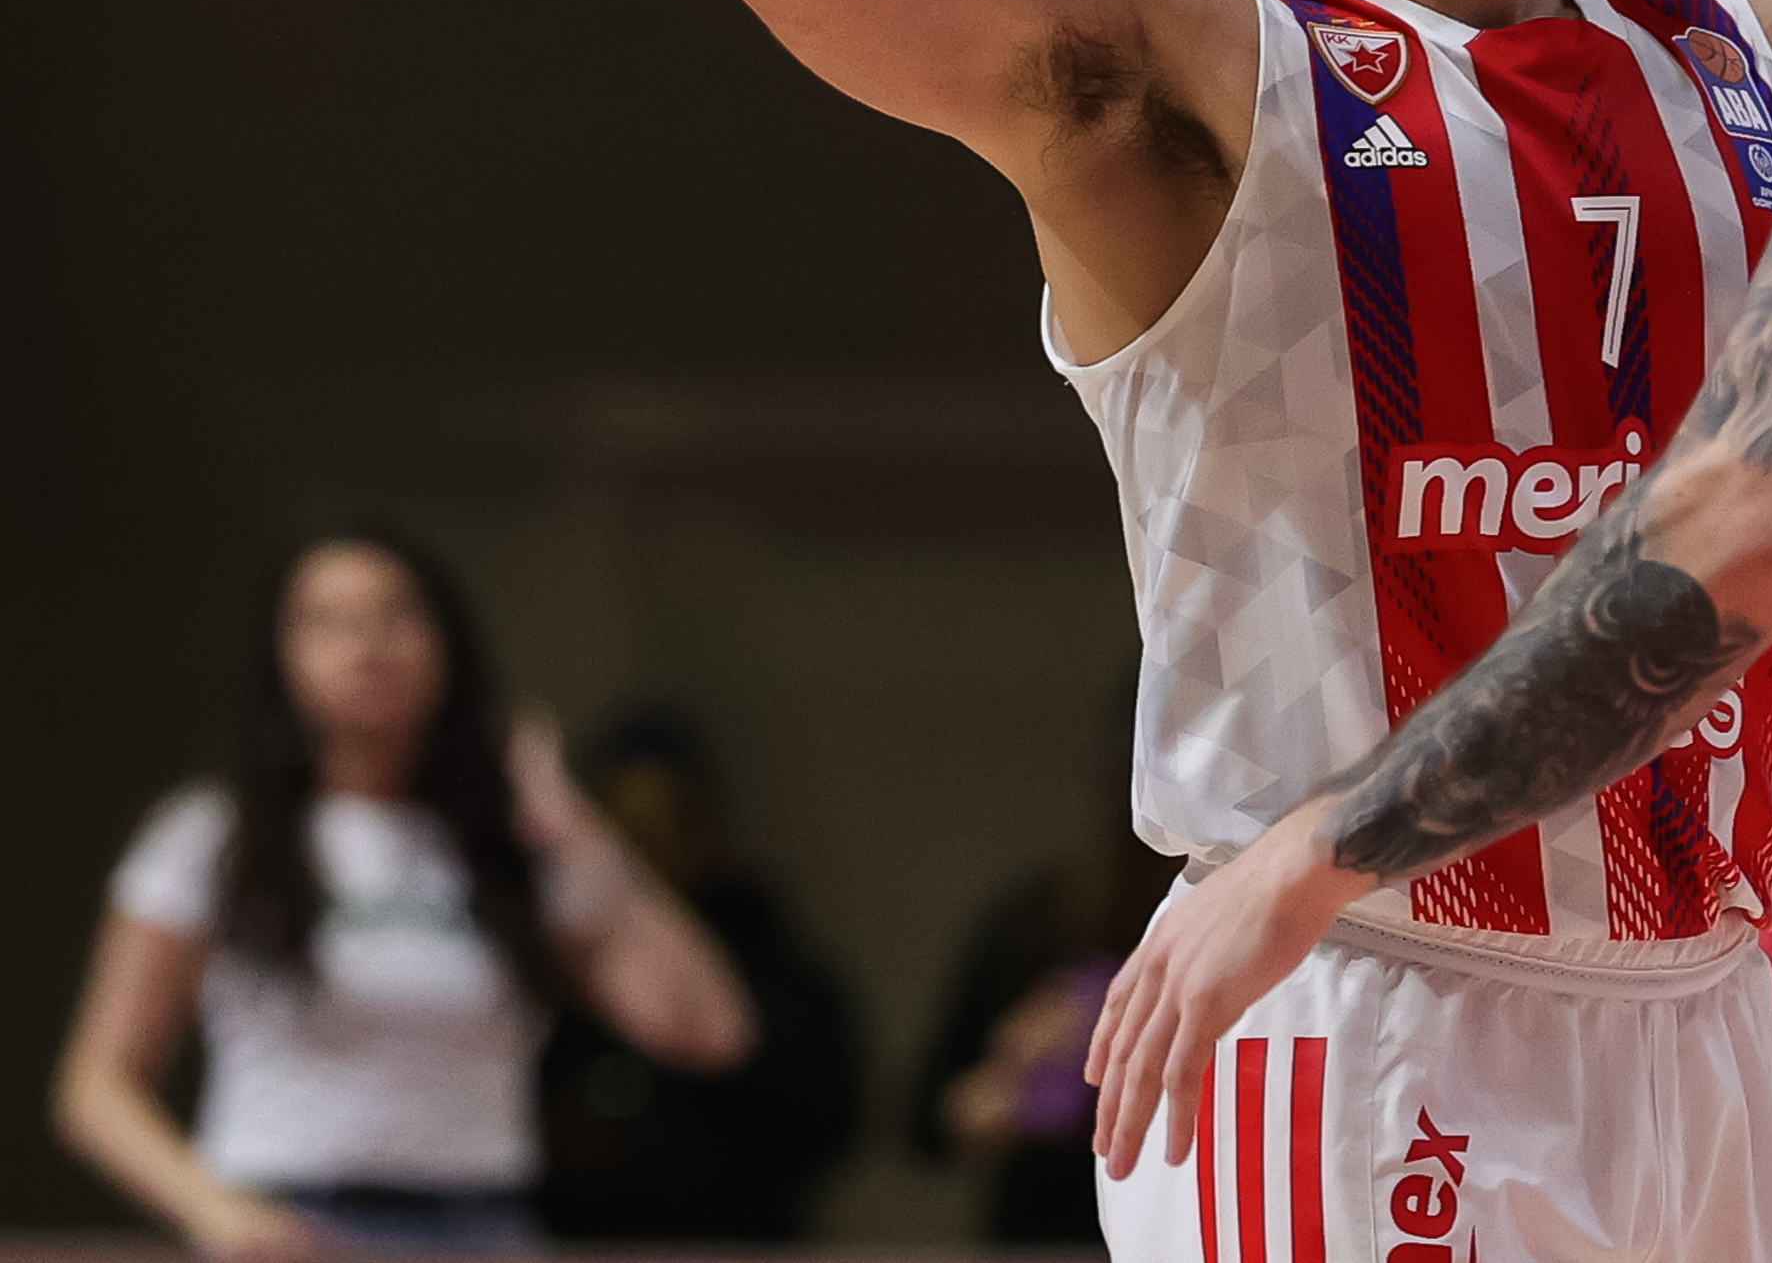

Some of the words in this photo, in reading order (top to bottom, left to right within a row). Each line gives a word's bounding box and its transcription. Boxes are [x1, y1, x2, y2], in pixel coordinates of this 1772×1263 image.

[1711, 86, 1769, 132] ABA
[1343, 145, 1428, 169] adidas
[1570, 195, 1641, 369] 7
